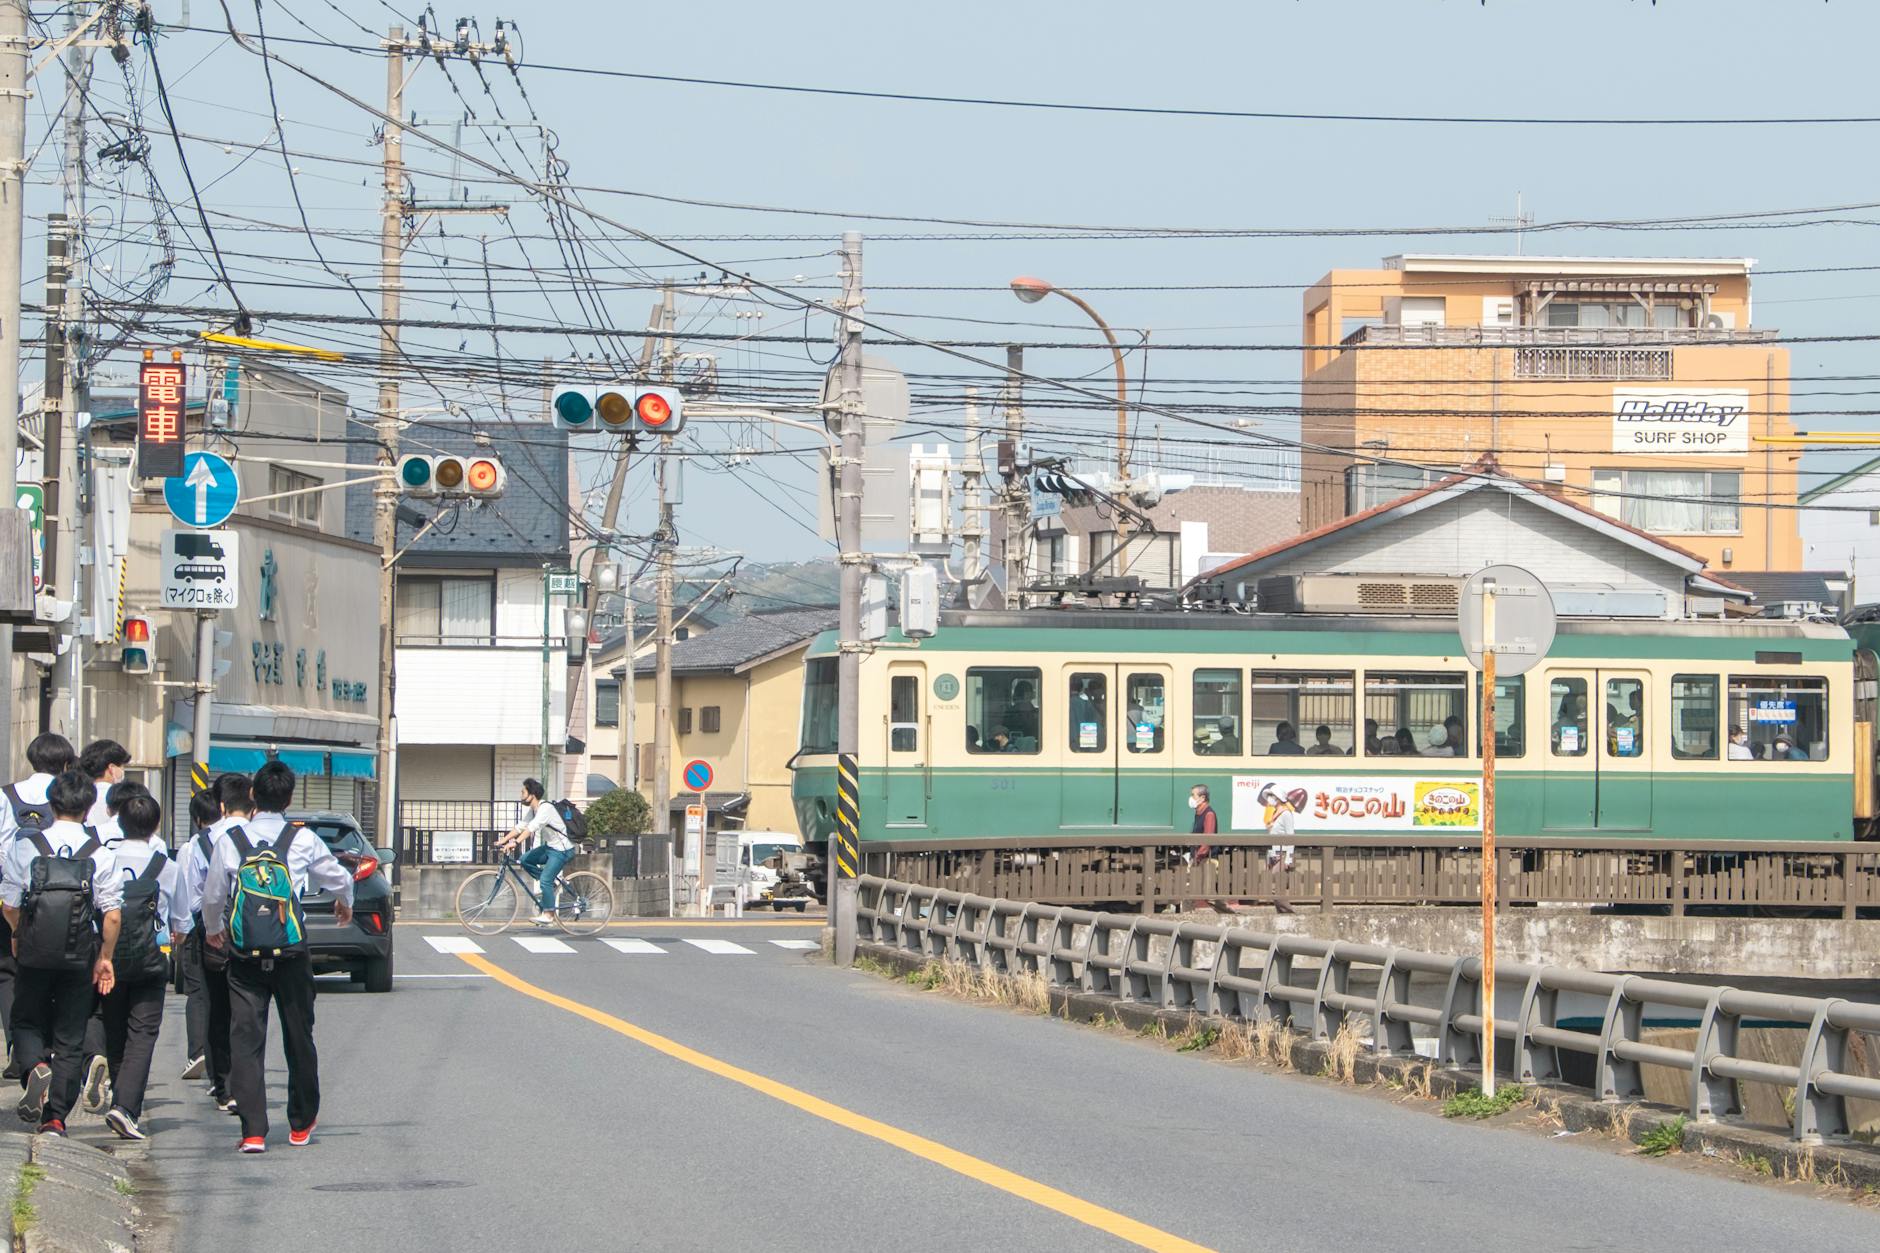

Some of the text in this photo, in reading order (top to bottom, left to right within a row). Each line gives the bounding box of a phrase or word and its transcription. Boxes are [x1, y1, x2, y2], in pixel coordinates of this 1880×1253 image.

[143, 368, 181, 443] 電車
[1618, 401, 1744, 426] Holiday
[1634, 431, 1728, 445] SURF SHOP
[165, 586, 234, 604] (マイクロを除く)
[1236, 778, 1260, 789] meiji
[1314, 791, 1406, 819] きのこの山
[1428, 793, 1466, 805] きのこの山
